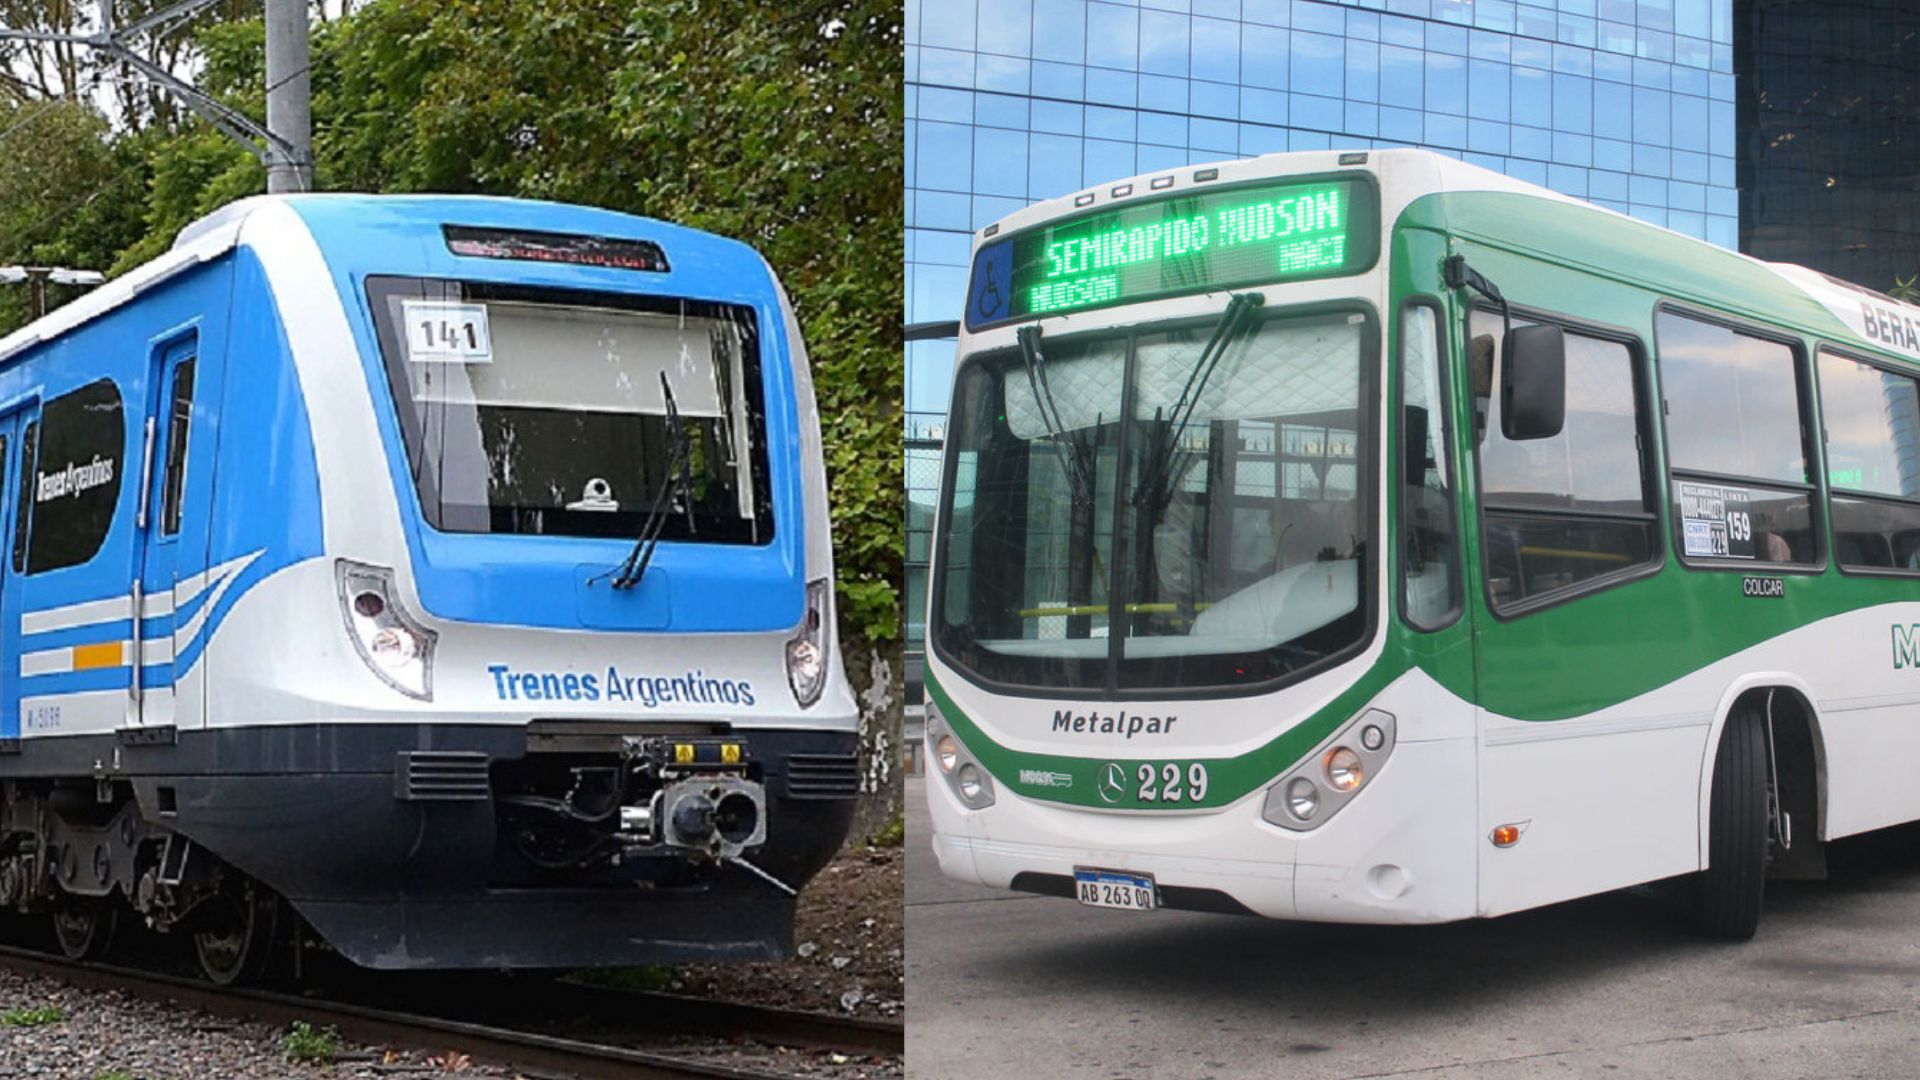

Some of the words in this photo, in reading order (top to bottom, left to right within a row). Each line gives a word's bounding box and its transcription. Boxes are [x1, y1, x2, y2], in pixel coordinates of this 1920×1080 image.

[1047, 215, 1208, 277] SEMIRAPIDO
[1216, 190, 1339, 248] HUDSON
[421, 320, 477, 349] 141
[1861, 302, 1920, 352] BERA
[1727, 511, 1751, 541] 159
[1743, 578, 1784, 596] COLCAR
[488, 665, 600, 700] Trenes
[606, 666, 756, 707] Argentinos
[1052, 710, 1177, 739] Metalpar
[1137, 763, 1209, 803] 229
[1081, 883, 1099, 902] AB
[1103, 885, 1131, 905] 263
